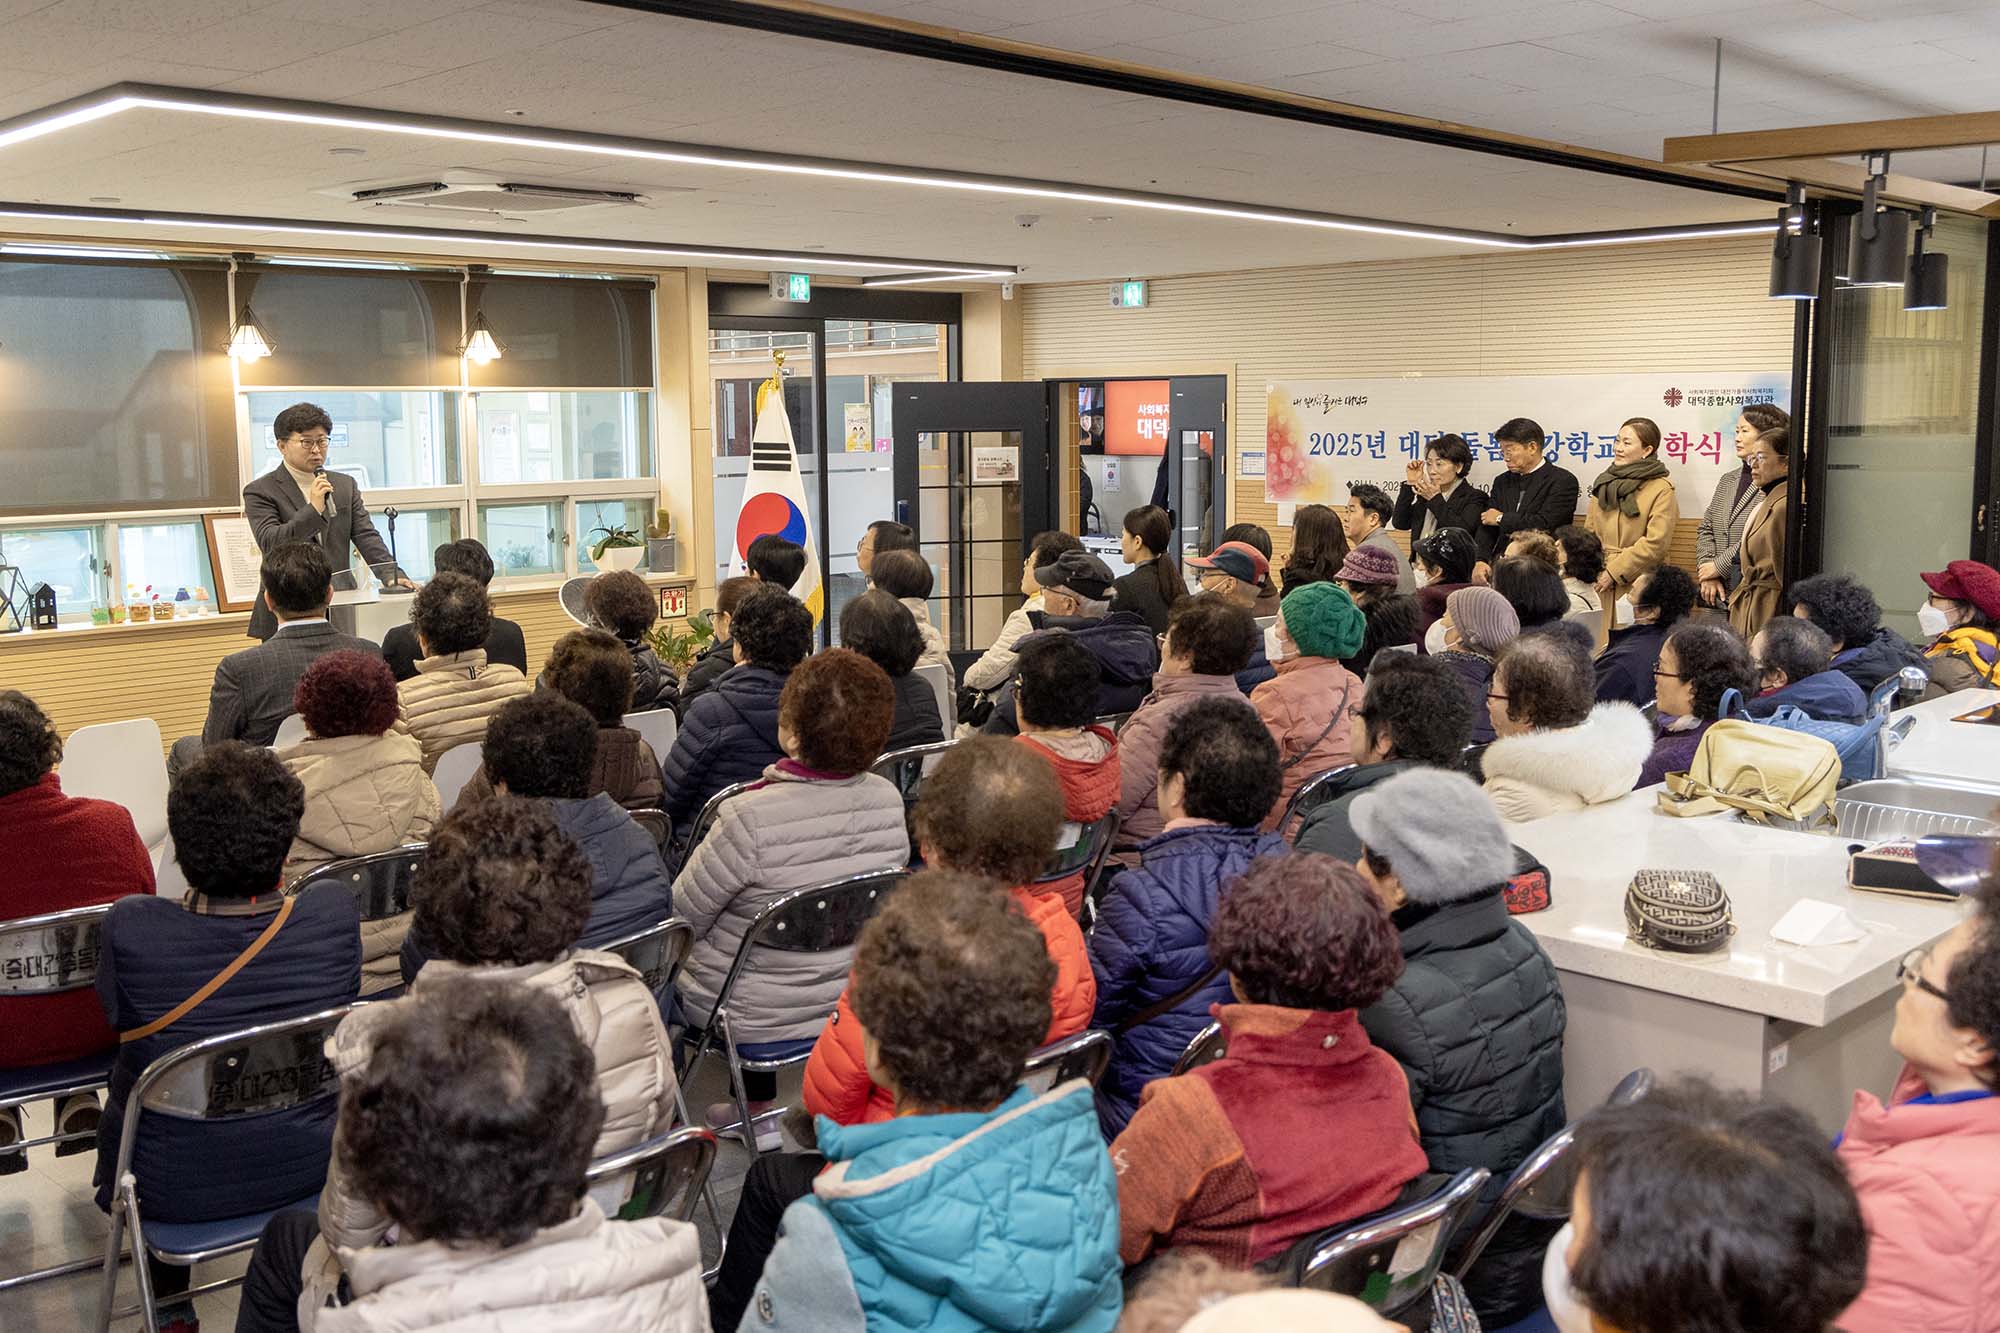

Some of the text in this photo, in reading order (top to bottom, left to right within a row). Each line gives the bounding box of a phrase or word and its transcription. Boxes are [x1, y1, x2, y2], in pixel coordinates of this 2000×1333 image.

[1687, 395, 1774, 407] 대덕종합사회복지관
[1137, 418, 1170, 439] 대덕
[1309, 430, 1386, 460] 2025년
[1663, 431, 1722, 465] 학식
[1383, 480, 1402, 492] 202
